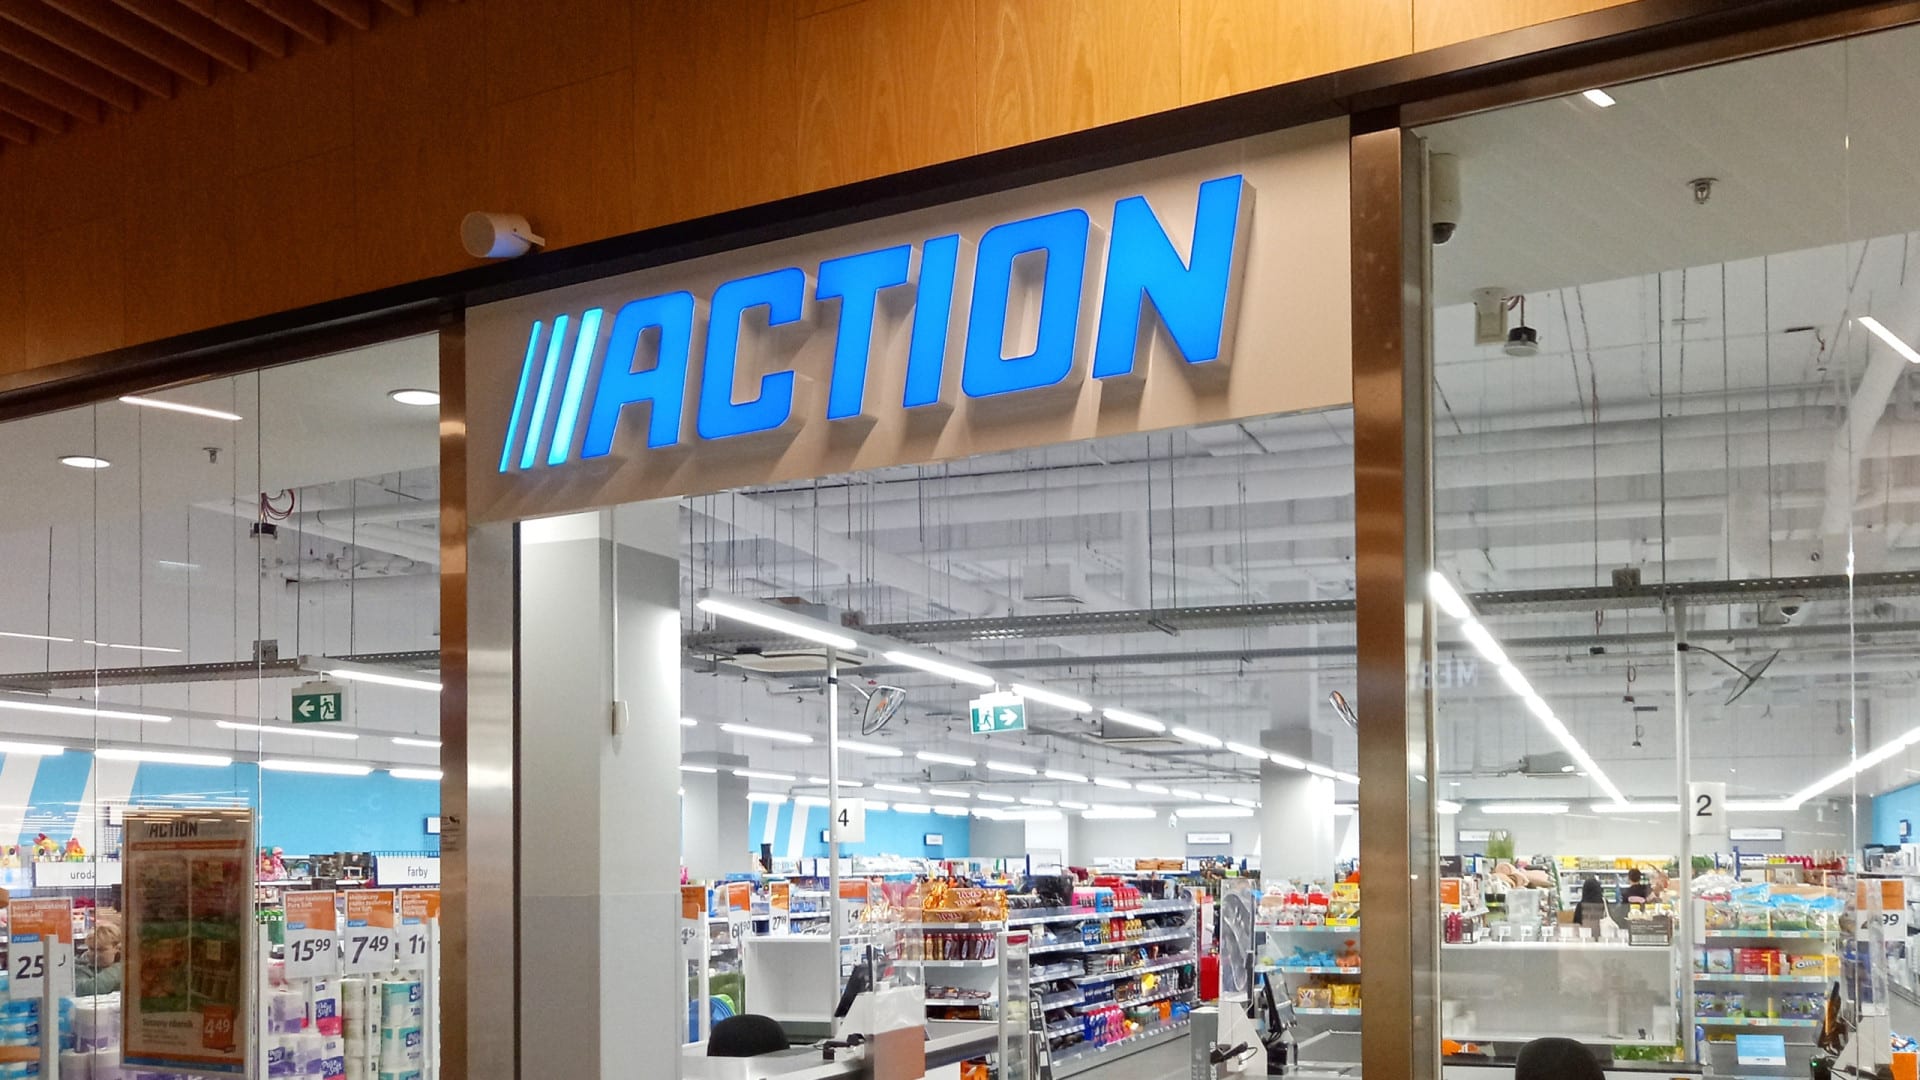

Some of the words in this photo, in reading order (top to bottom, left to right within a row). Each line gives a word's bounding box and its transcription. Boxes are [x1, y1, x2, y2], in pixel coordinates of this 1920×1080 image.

[581, 173, 1243, 460] ACTION
[1695, 795, 1713, 817] 2
[837, 809, 849, 827] 4
[148, 821, 198, 838] ACTION
[407, 866, 429, 878] farby
